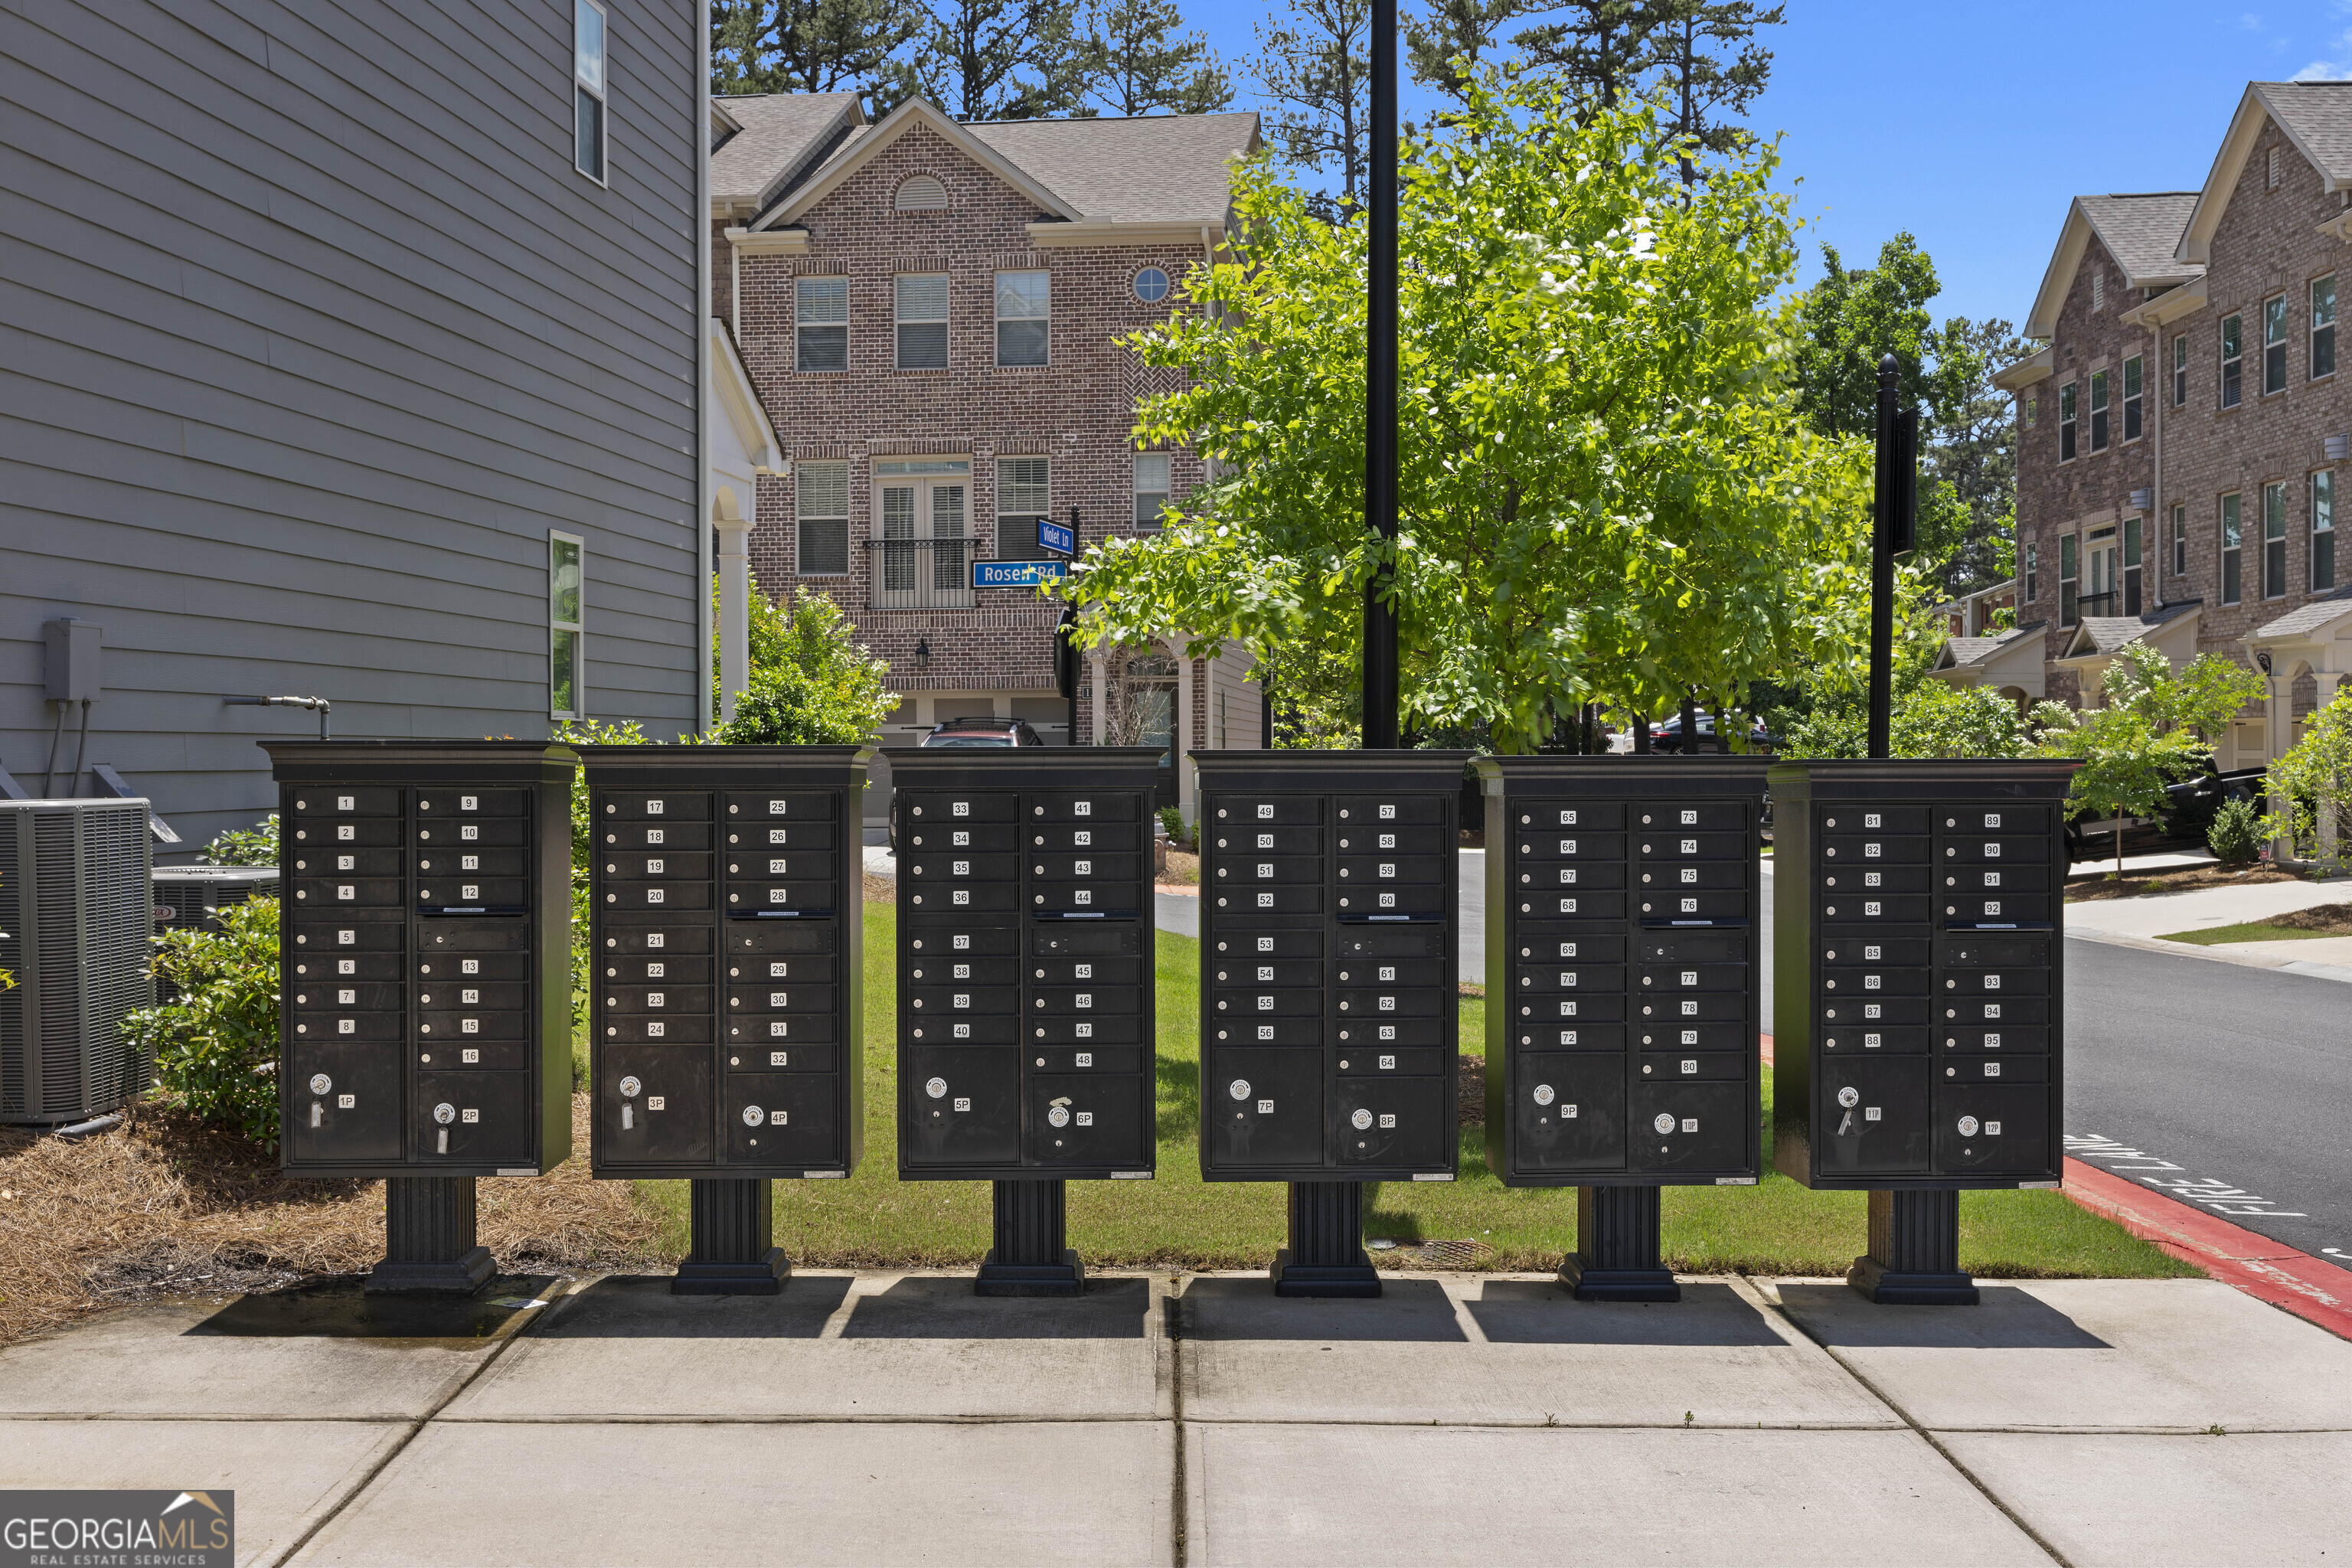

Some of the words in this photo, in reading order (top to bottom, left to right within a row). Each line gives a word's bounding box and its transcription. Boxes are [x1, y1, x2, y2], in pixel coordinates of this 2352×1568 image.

[1044, 527, 1059, 545] Violet
[1062, 532, 1069, 547] Ln
[985, 567, 1029, 581] Rosen
[1038, 565, 1056, 580] Rd
[650, 803, 661, 811] 17
[772, 803, 784, 811] 25
[955, 805, 967, 813] 33
[1077, 804, 1087, 812] 41
[1260, 807, 1271, 816] 49
[1382, 807, 1393, 816] 57
[1563, 813, 1574, 821] 65
[1683, 813, 1695, 821] 73
[1867, 817, 1877, 825] 81
[1987, 816, 1998, 825] 89
[464, 828, 475, 837] 10
[650, 832, 661, 841] 18
[772, 832, 784, 840] 26
[955, 834, 967, 843] 34
[1077, 834, 1088, 842] 42
[1260, 837, 1271, 845] 50
[1382, 837, 1393, 845] 58
[1562, 843, 1574, 851] 66
[1683, 842, 1695, 850] 74
[1867, 846, 1878, 854] 82
[1987, 846, 1999, 854] 90
[464, 858, 474, 867] 11
[650, 862, 661, 870] 19
[772, 862, 784, 870] 27
[955, 864, 967, 872] 35
[1077, 863, 1089, 872] 43
[1260, 866, 1270, 875] 51
[1382, 866, 1393, 875] 59
[1562, 872, 1574, 880] 67
[1683, 872, 1695, 880] 75
[1868, 875, 1879, 883] 83
[1986, 875, 1996, 883] 91
[464, 888, 475, 896] 12
[650, 892, 661, 900] 20
[772, 892, 784, 900] 28
[955, 893, 967, 902] 36
[1077, 893, 1089, 901] 44
[1260, 896, 1271, 904] 52
[1381, 896, 1393, 904] 60
[1563, 901, 1574, 909] 68
[1683, 901, 1695, 909] 76
[1867, 905, 1879, 913] 84
[1987, 904, 1999, 912] 92
[650, 936, 660, 944] 21
[956, 938, 967, 946] 37
[1260, 940, 1271, 948] 53
[1562, 945, 1574, 954] 69
[1867, 948, 1879, 957] 85
[465, 962, 475, 971] 13
[650, 966, 661, 974] 22
[773, 965, 784, 974] 29
[956, 967, 967, 976] 38
[1078, 967, 1089, 975] 45
[1260, 969, 1271, 978] 54
[1381, 970, 1391, 978] 61
[1563, 975, 1574, 983] 70
[1683, 974, 1695, 982] 77
[1867, 978, 1878, 986] 86
[1986, 978, 1998, 986] 93
[465, 992, 476, 1000] 14
[650, 996, 662, 1004] 23
[773, 995, 784, 1004] 30
[956, 997, 967, 1005] 39
[1078, 997, 1089, 1005] 46
[1260, 999, 1271, 1007] 55
[1381, 999, 1392, 1008] 62
[1563, 1004, 1574, 1012] 71
[1684, 1004, 1695, 1012] 78
[1867, 1007, 1878, 1016] 87
[465, 1022, 476, 1030] 15
[650, 1025, 662, 1033] 24
[773, 1025, 783, 1033] 31
[956, 1027, 967, 1035] 40
[1260, 1029, 1271, 1037] 56
[1381, 1029, 1393, 1037] 63
[1563, 1034, 1574, 1042] 72
[1684, 1033, 1695, 1041] 79
[1867, 1036, 1878, 1045] 88
[1986, 1036, 1998, 1045] 95
[465, 1052, 476, 1060] 16
[773, 1055, 784, 1063] 32
[1078, 1055, 1090, 1064] 48
[1381, 1058, 1393, 1066] 64
[1683, 1062, 1695, 1071] 80
[1986, 1065, 1998, 1074] 96
[340, 1097, 352, 1105] 1P
[650, 1099, 663, 1108] 3P
[1259, 1102, 1272, 1111] 7P
[1563, 1107, 1576, 1115] 9P
[1868, 1110, 1879, 1118] 11P
[464, 1112, 476, 1120] 2P
[773, 1114, 785, 1122] 4P
[1078, 1115, 1091, 1123] 6P
[1381, 1117, 1394, 1125] 8P
[1685, 1121, 1695, 1130] 10P
[1988, 1124, 1998, 1132] 12P
[2063, 1134, 2186, 1170] LANE
[2140, 1178, 2308, 1217] FIRE
